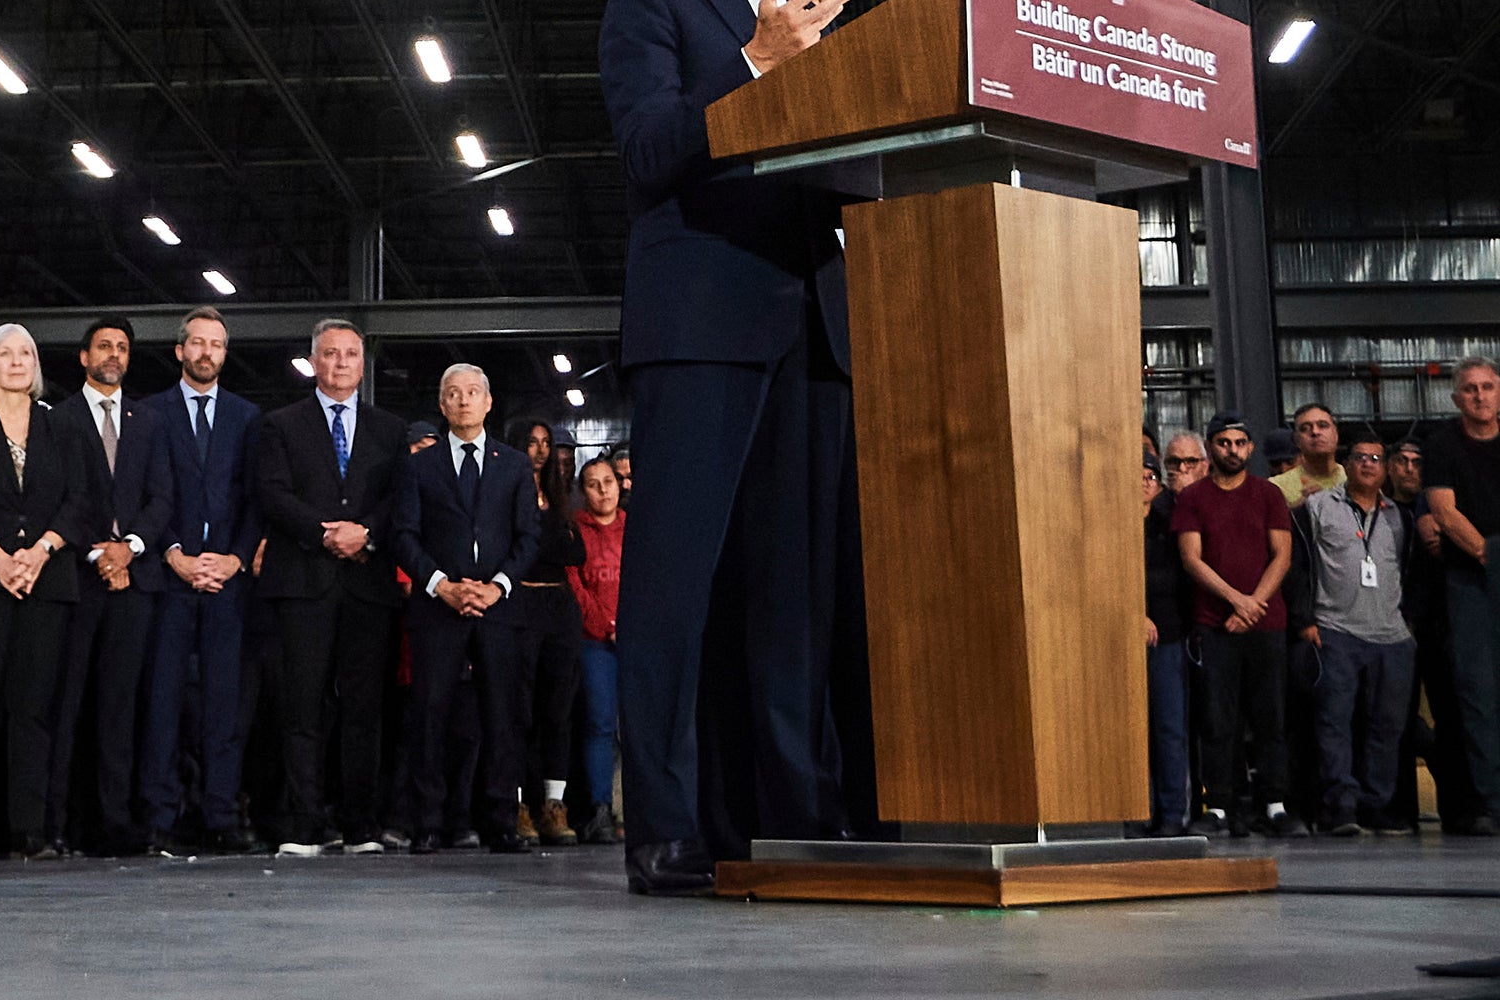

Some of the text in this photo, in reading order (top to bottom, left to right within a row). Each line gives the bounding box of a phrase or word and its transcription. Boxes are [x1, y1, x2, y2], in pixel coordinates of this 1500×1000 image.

[1032, 43, 1207, 112] Bâtir un Canada fort
[1094, 16, 1159, 56] Canada
[1160, 33, 1217, 77] Strong
